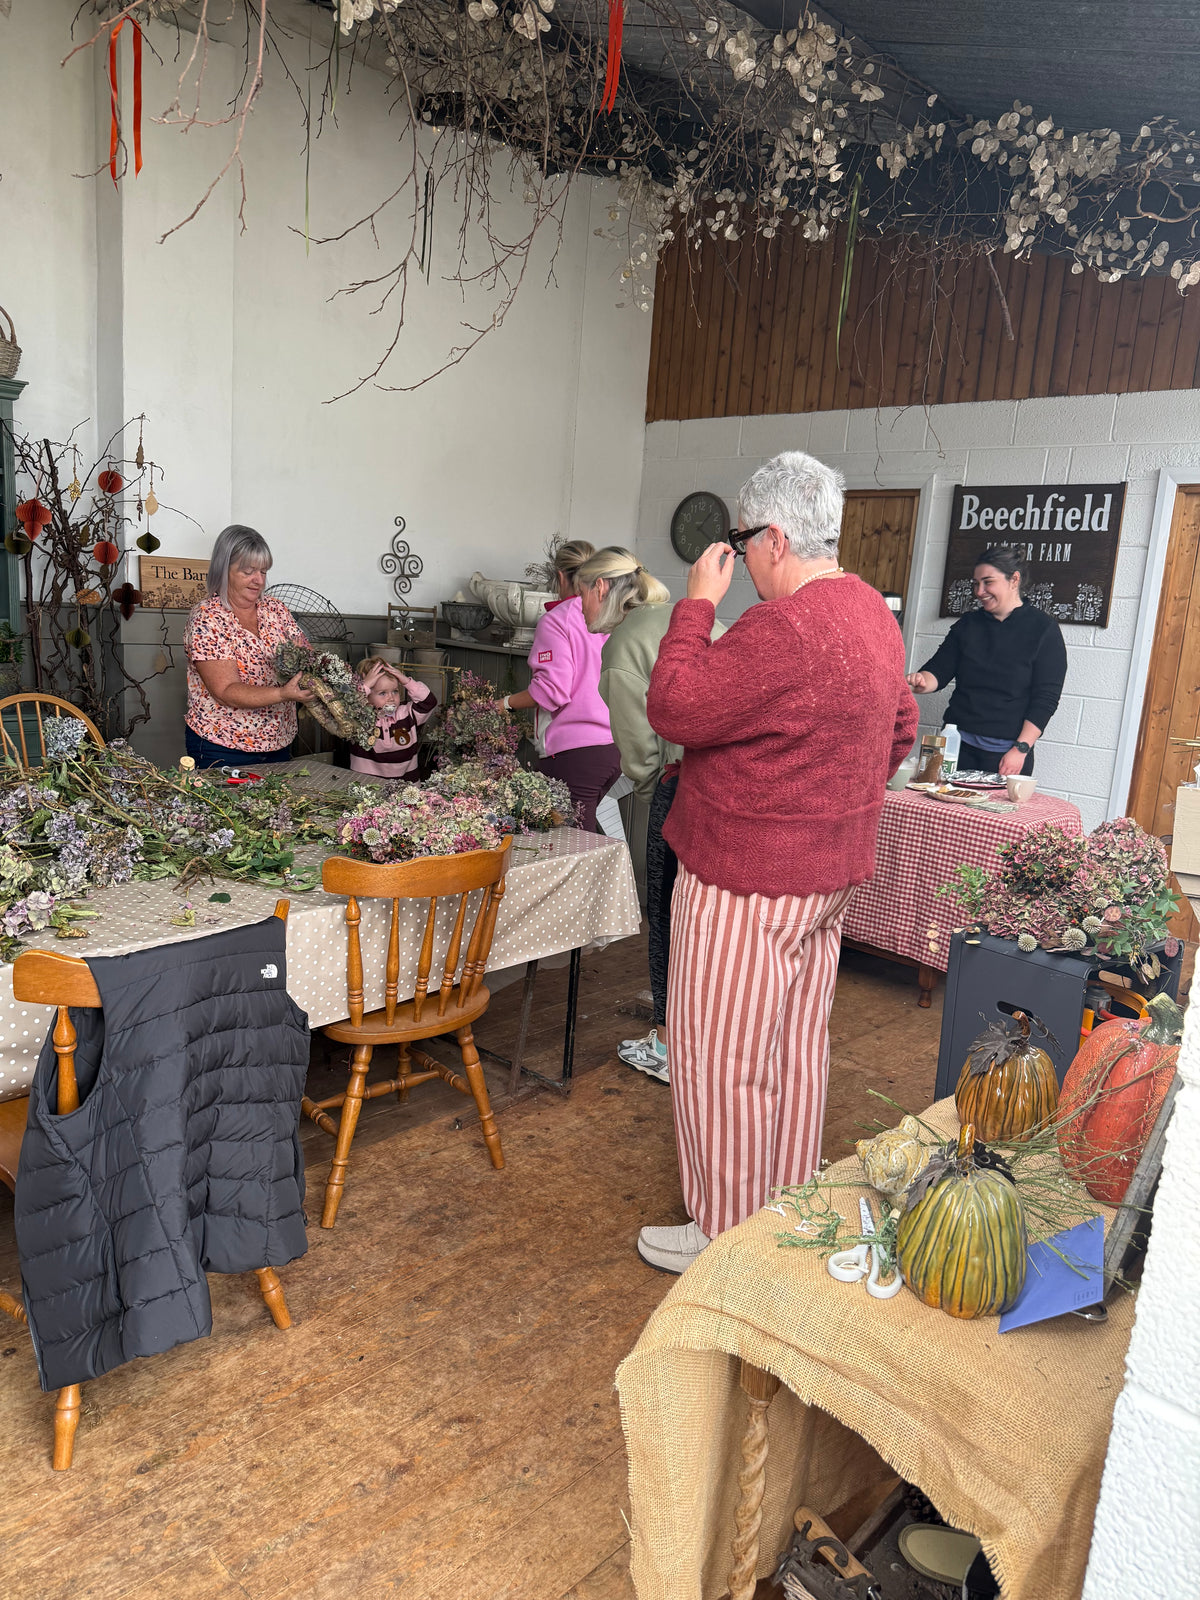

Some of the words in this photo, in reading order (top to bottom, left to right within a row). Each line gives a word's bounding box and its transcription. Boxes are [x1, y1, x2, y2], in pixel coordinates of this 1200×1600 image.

[959, 493, 1112, 532] Beechfield
[1039, 543, 1072, 561] FARM
[151, 565, 178, 579] The
